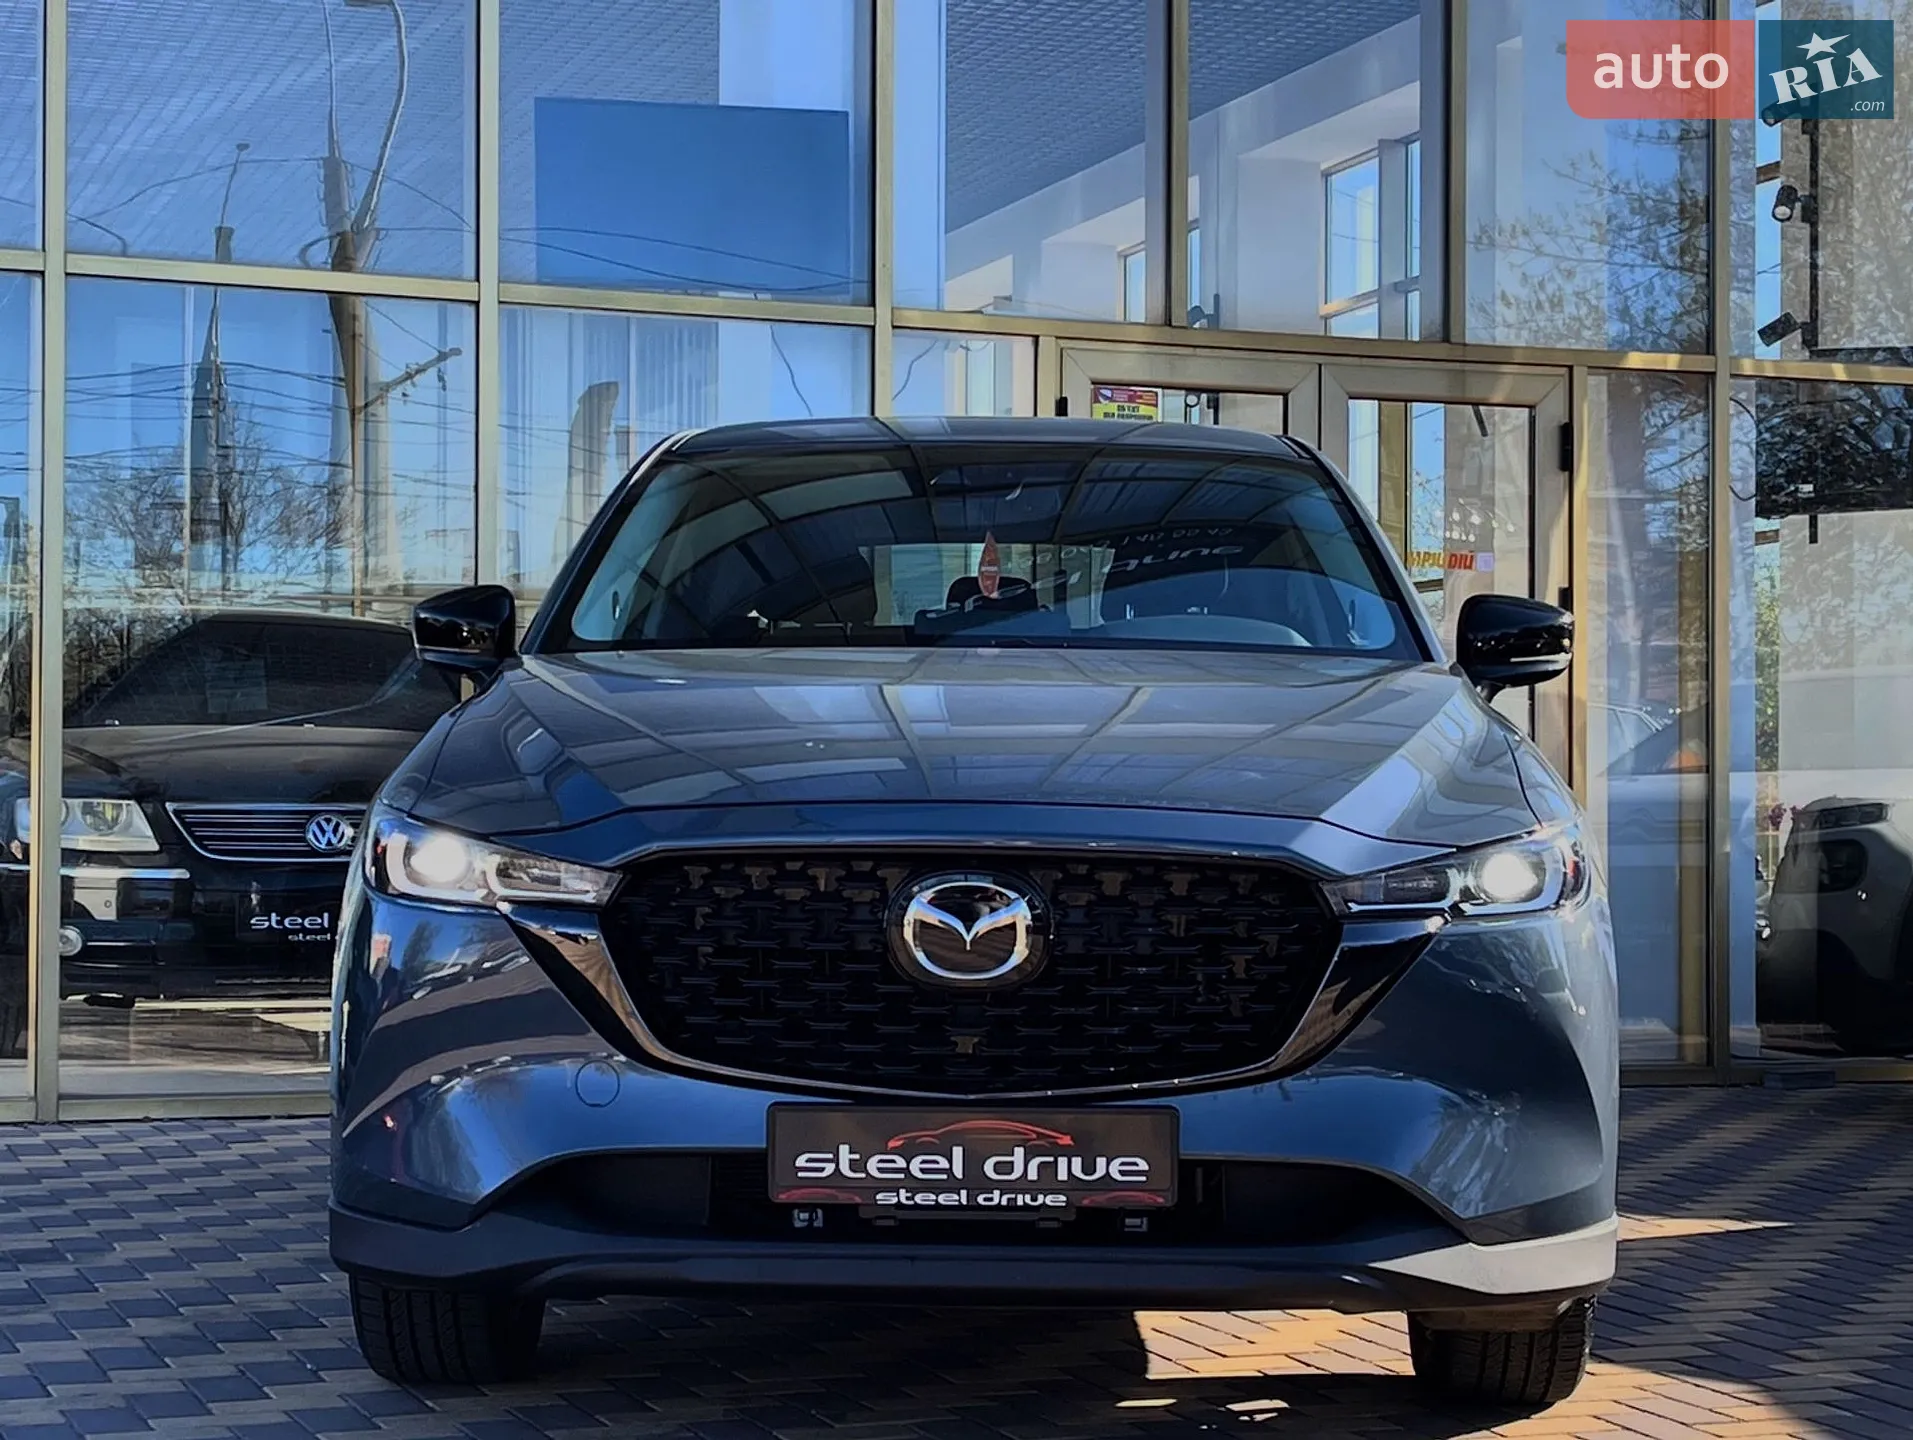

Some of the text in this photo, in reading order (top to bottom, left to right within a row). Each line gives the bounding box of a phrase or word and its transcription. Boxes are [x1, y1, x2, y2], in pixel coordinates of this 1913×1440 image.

[250, 912, 329, 929] steel
[288, 933, 331, 941] steel
[795, 1144, 1150, 1181] steel drive
[875, 1188, 1068, 1207] steel drive
